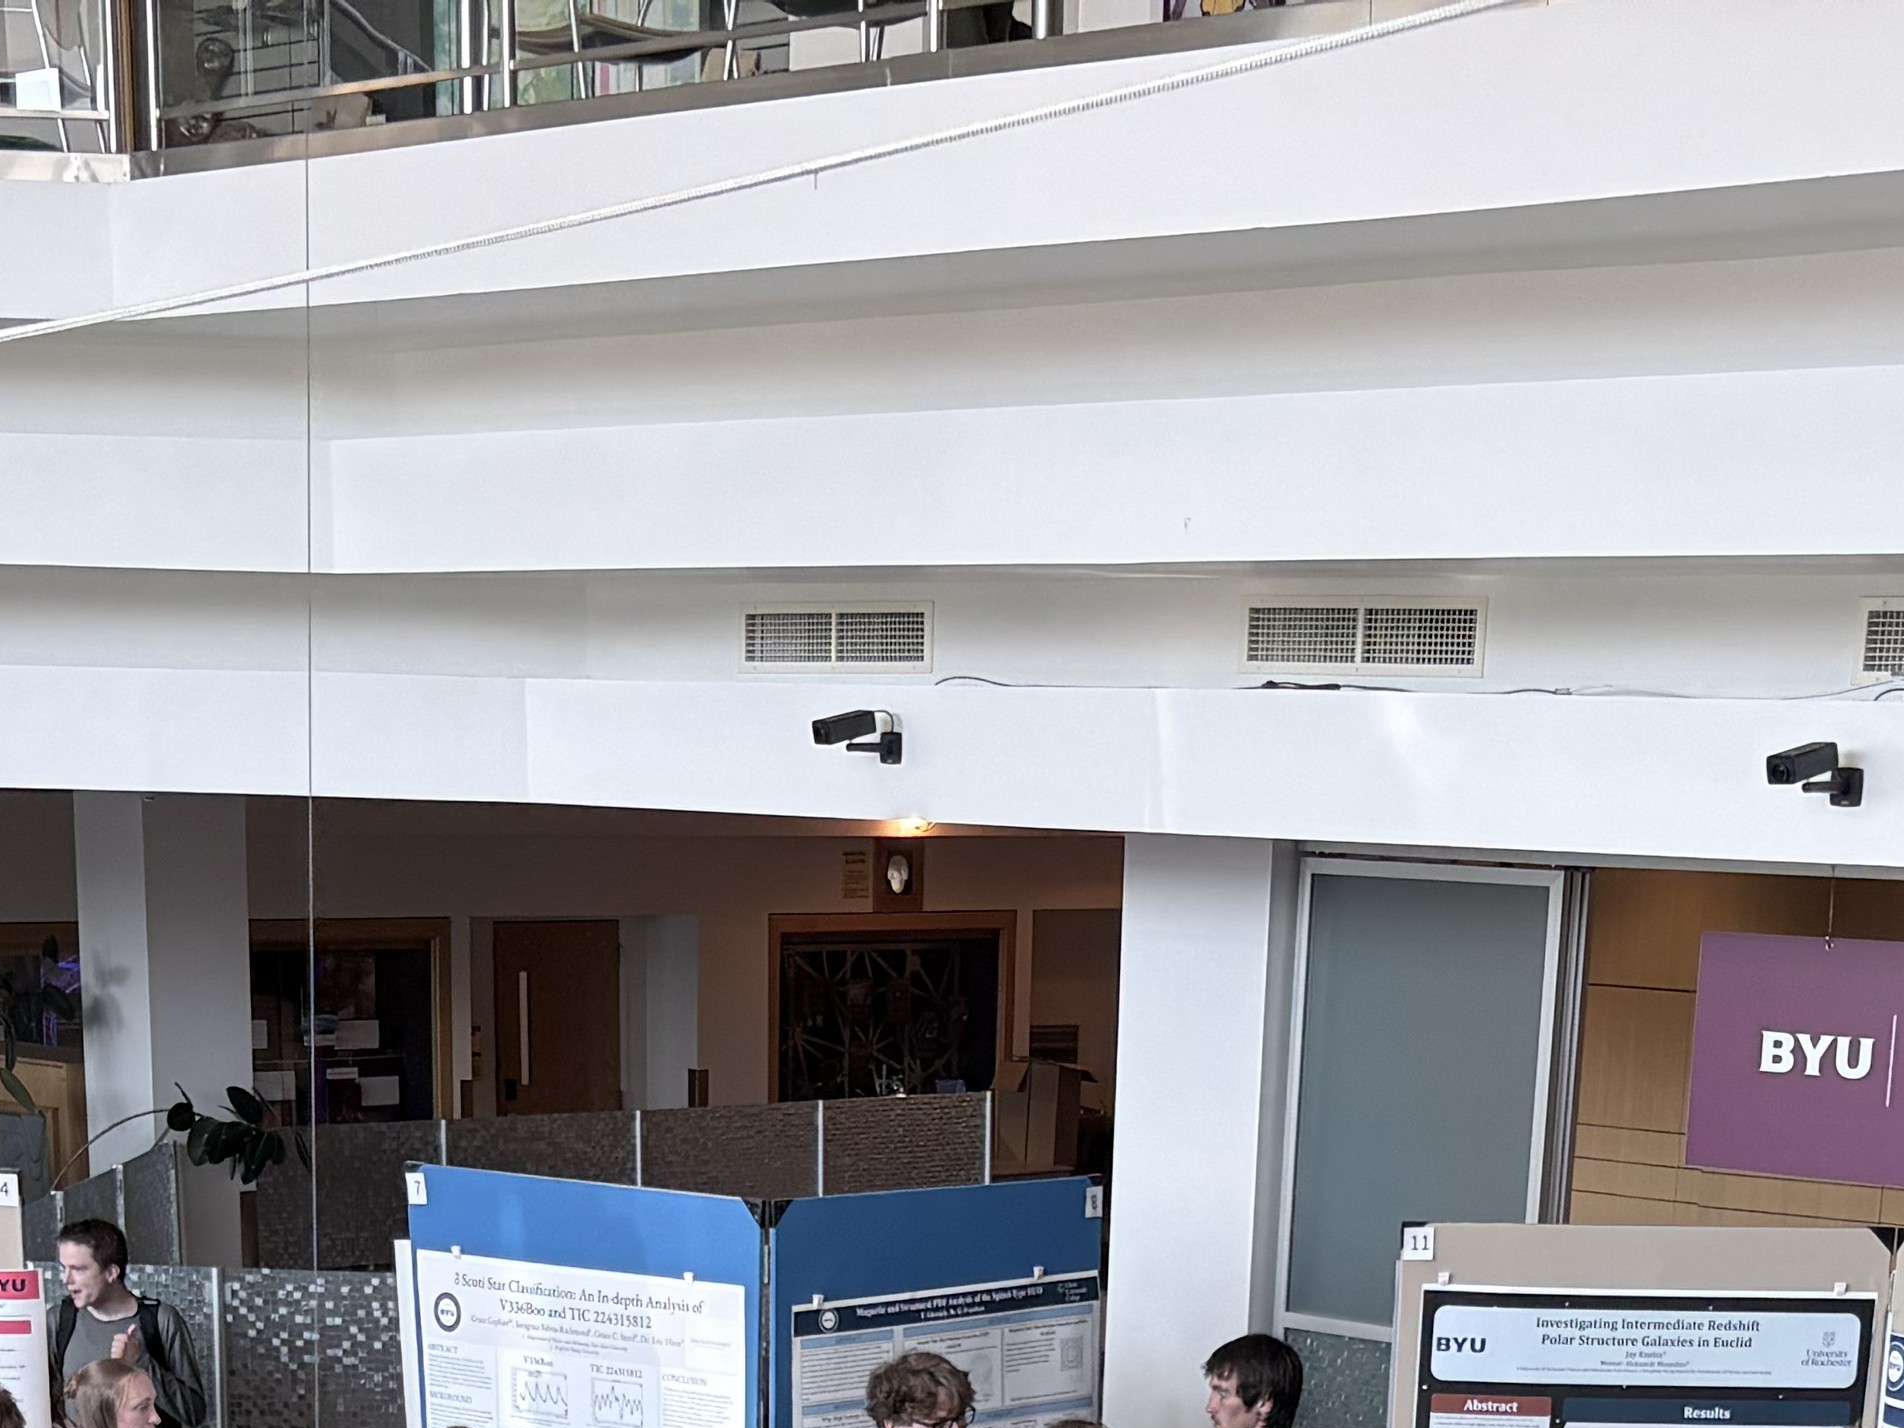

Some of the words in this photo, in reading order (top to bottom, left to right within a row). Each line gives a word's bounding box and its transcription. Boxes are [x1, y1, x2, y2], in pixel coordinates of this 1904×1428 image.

[1759, 1030, 1875, 1080] BYU
[0, 1181, 9, 1197] 4
[414, 1181, 421, 1196] 7
[1411, 1234, 1430, 1251] 11
[488, 1279, 505, 1291] Star
[579, 1289, 594, 1302] An
[647, 1296, 689, 1314] Analysis
[693, 1300, 704, 1314] of
[548, 1306, 566, 1319] and
[570, 1307, 591, 1322] TIC
[1536, 1317, 1618, 1331] Investigating
[1621, 1319, 1704, 1332] Intermediate
[1708, 1319, 1760, 1332] Redshift
[1436, 1336, 1487, 1353] BYU
[1541, 1334, 1576, 1346] Polar
[1578, 1335, 1638, 1347] Structure
[1641, 1336, 1694, 1348] Galaxies
[1697, 1337, 1709, 1348] in
[1713, 1336, 1752, 1348] Euclid
[1464, 1399, 1518, 1413] Abstract
[1684, 1406, 1731, 1420] Results
